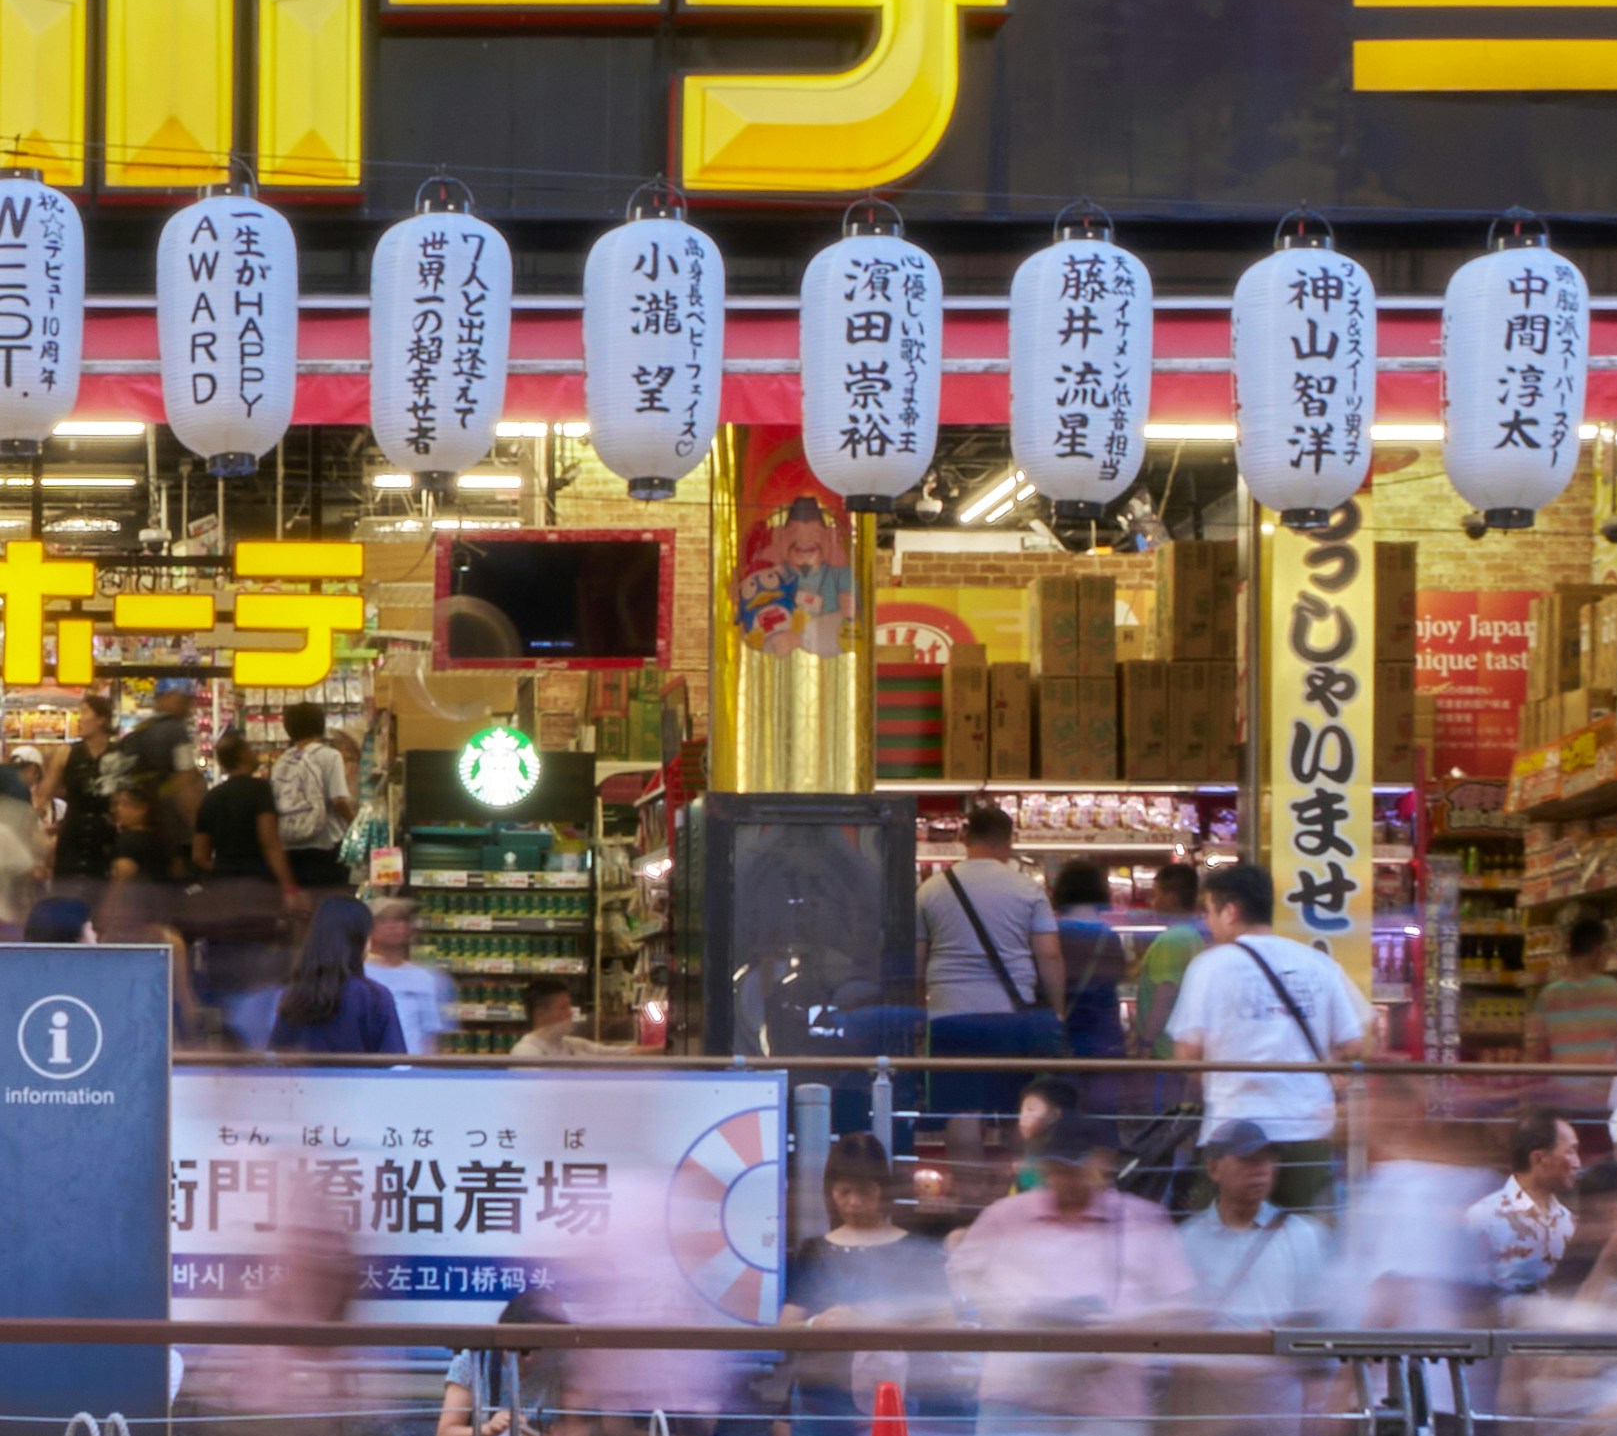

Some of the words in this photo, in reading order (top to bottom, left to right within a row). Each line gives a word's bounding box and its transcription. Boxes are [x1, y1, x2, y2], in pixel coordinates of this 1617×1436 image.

[190, 215, 220, 406] AWARD
[233, 212, 271, 420] 一生がHAPPY
[405, 232, 448, 456] 世界一の超幸せ者
[631, 239, 683, 414] 小瀧望
[1054, 255, 1110, 458] 藤井流星
[1098, 254, 1136, 482] 天然イケメン低音担当
[1286, 265, 1342, 475] 神山智洋
[1494, 267, 1549, 451] 中間淳太
[5, 1087, 115, 1105] information
[382, 1127, 434, 1148] ふな
[467, 1128, 518, 1150] つき
